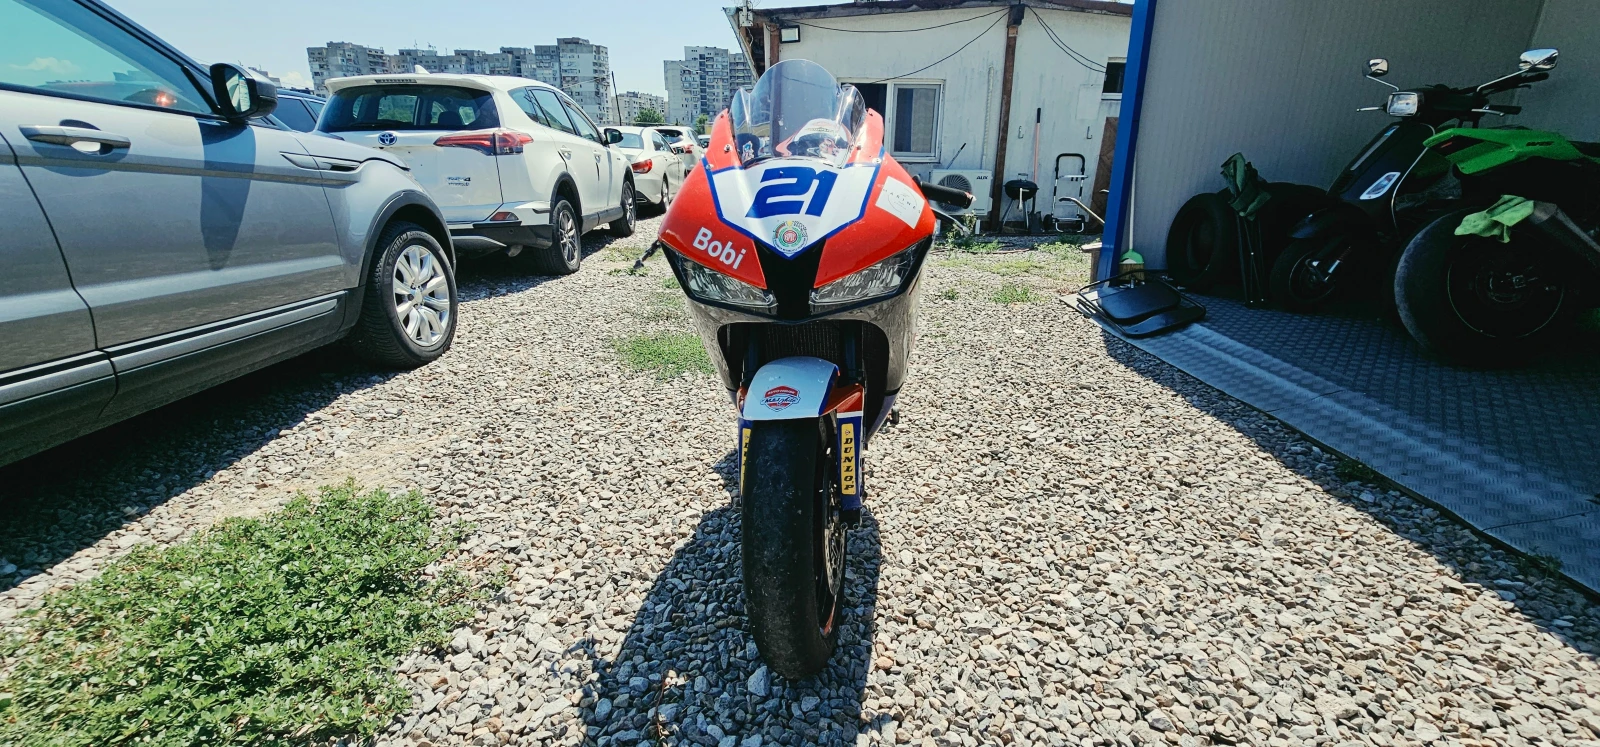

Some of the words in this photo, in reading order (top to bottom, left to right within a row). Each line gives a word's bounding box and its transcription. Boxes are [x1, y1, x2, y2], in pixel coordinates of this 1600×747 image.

[745, 166, 838, 219] 21
[692, 226, 747, 270] Bobi
[843, 437, 855, 490] DUNLOP
